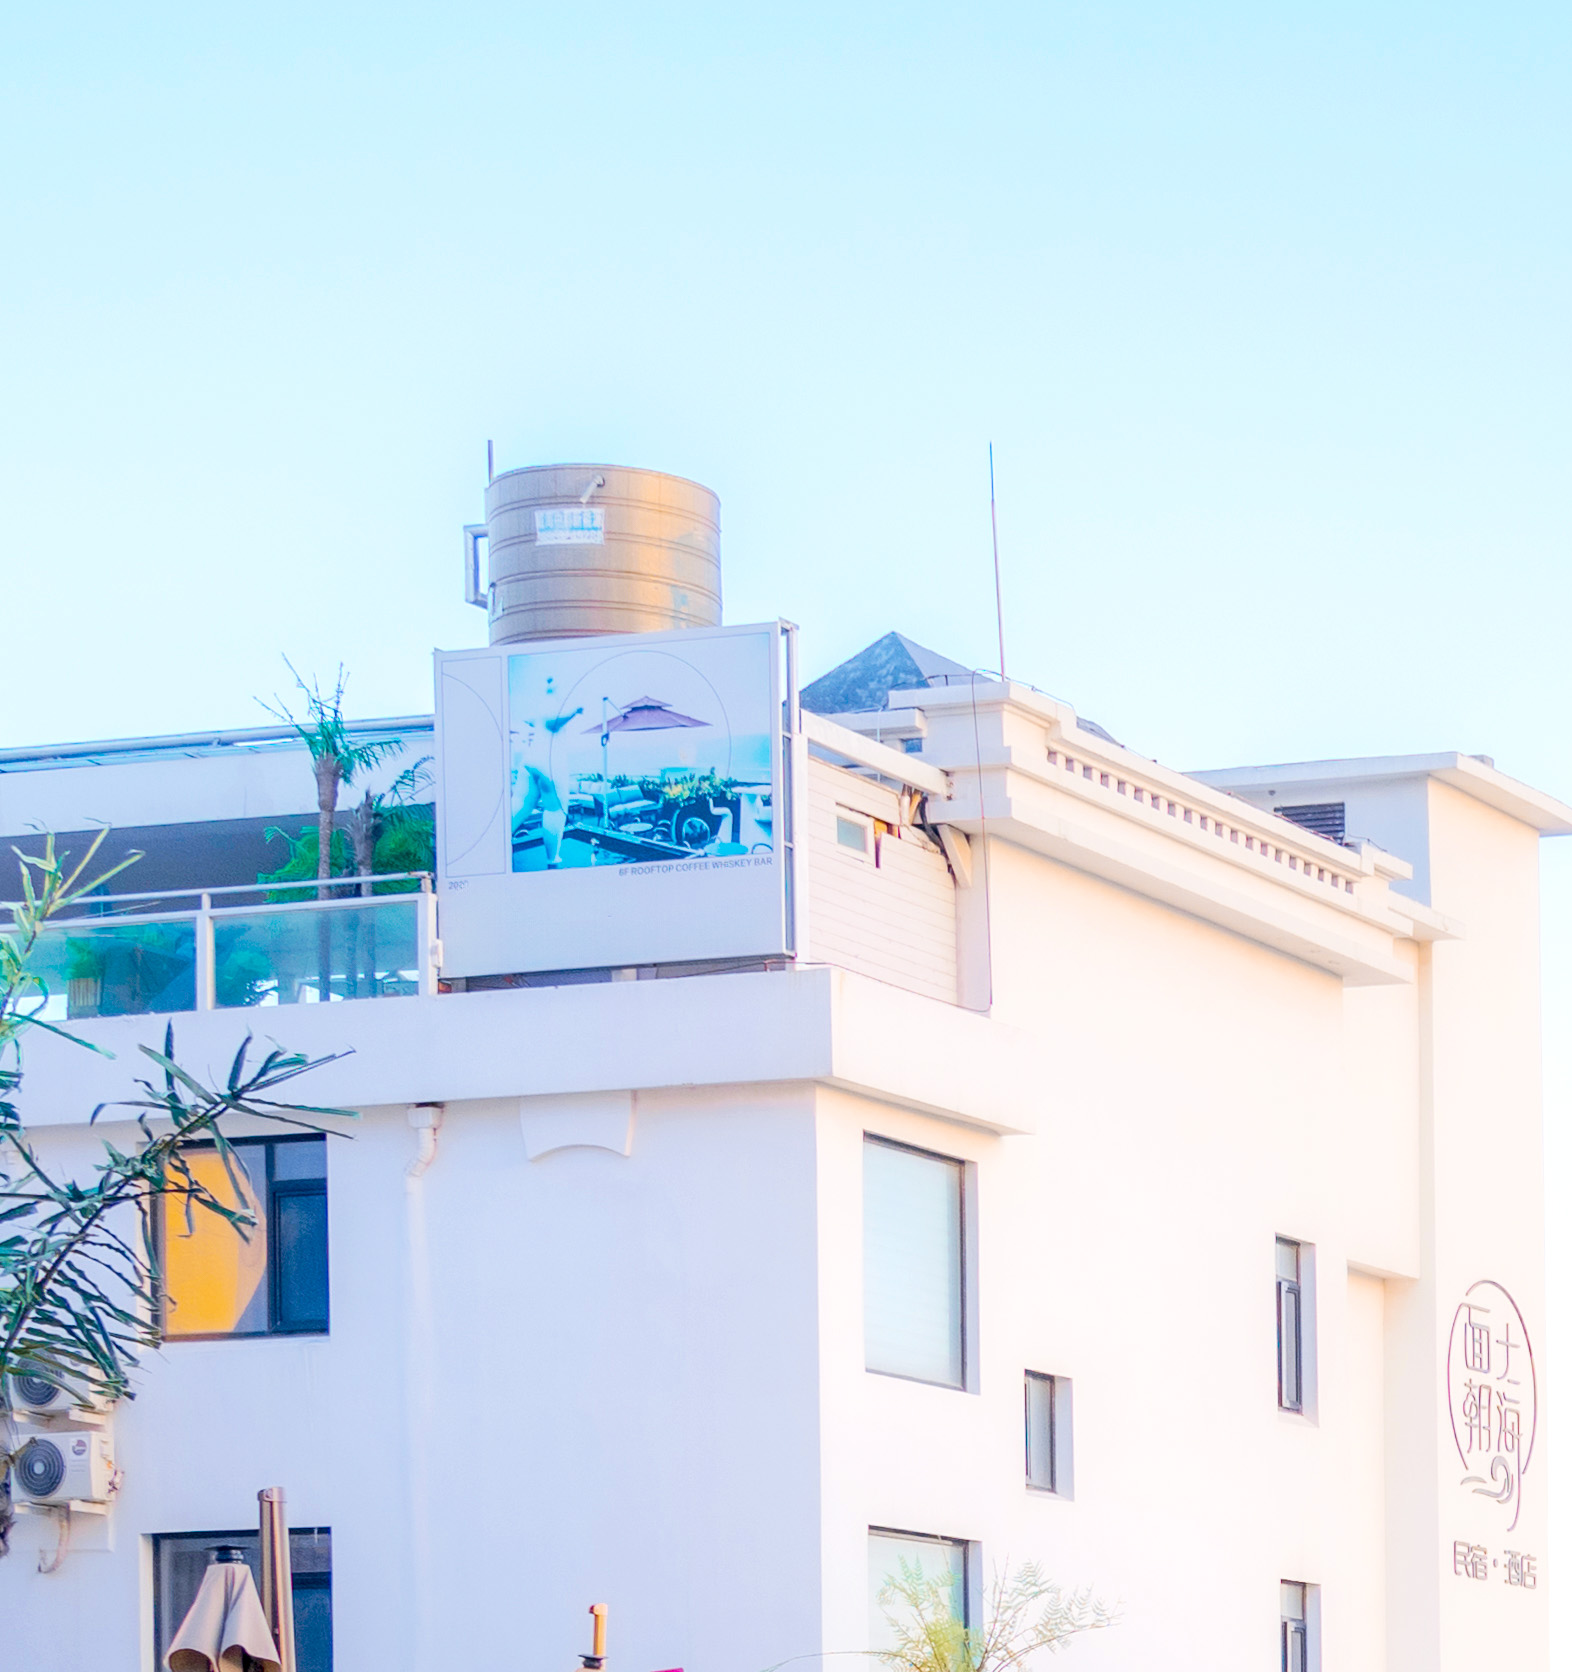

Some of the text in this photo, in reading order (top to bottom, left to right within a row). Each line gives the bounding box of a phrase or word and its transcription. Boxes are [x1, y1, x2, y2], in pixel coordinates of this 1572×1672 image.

[630, 864, 674, 875] ROOFTOP
[675, 862, 710, 872] COFFEE
[711, 859, 752, 870] WHISKEY
[754, 857, 773, 866] BAR
